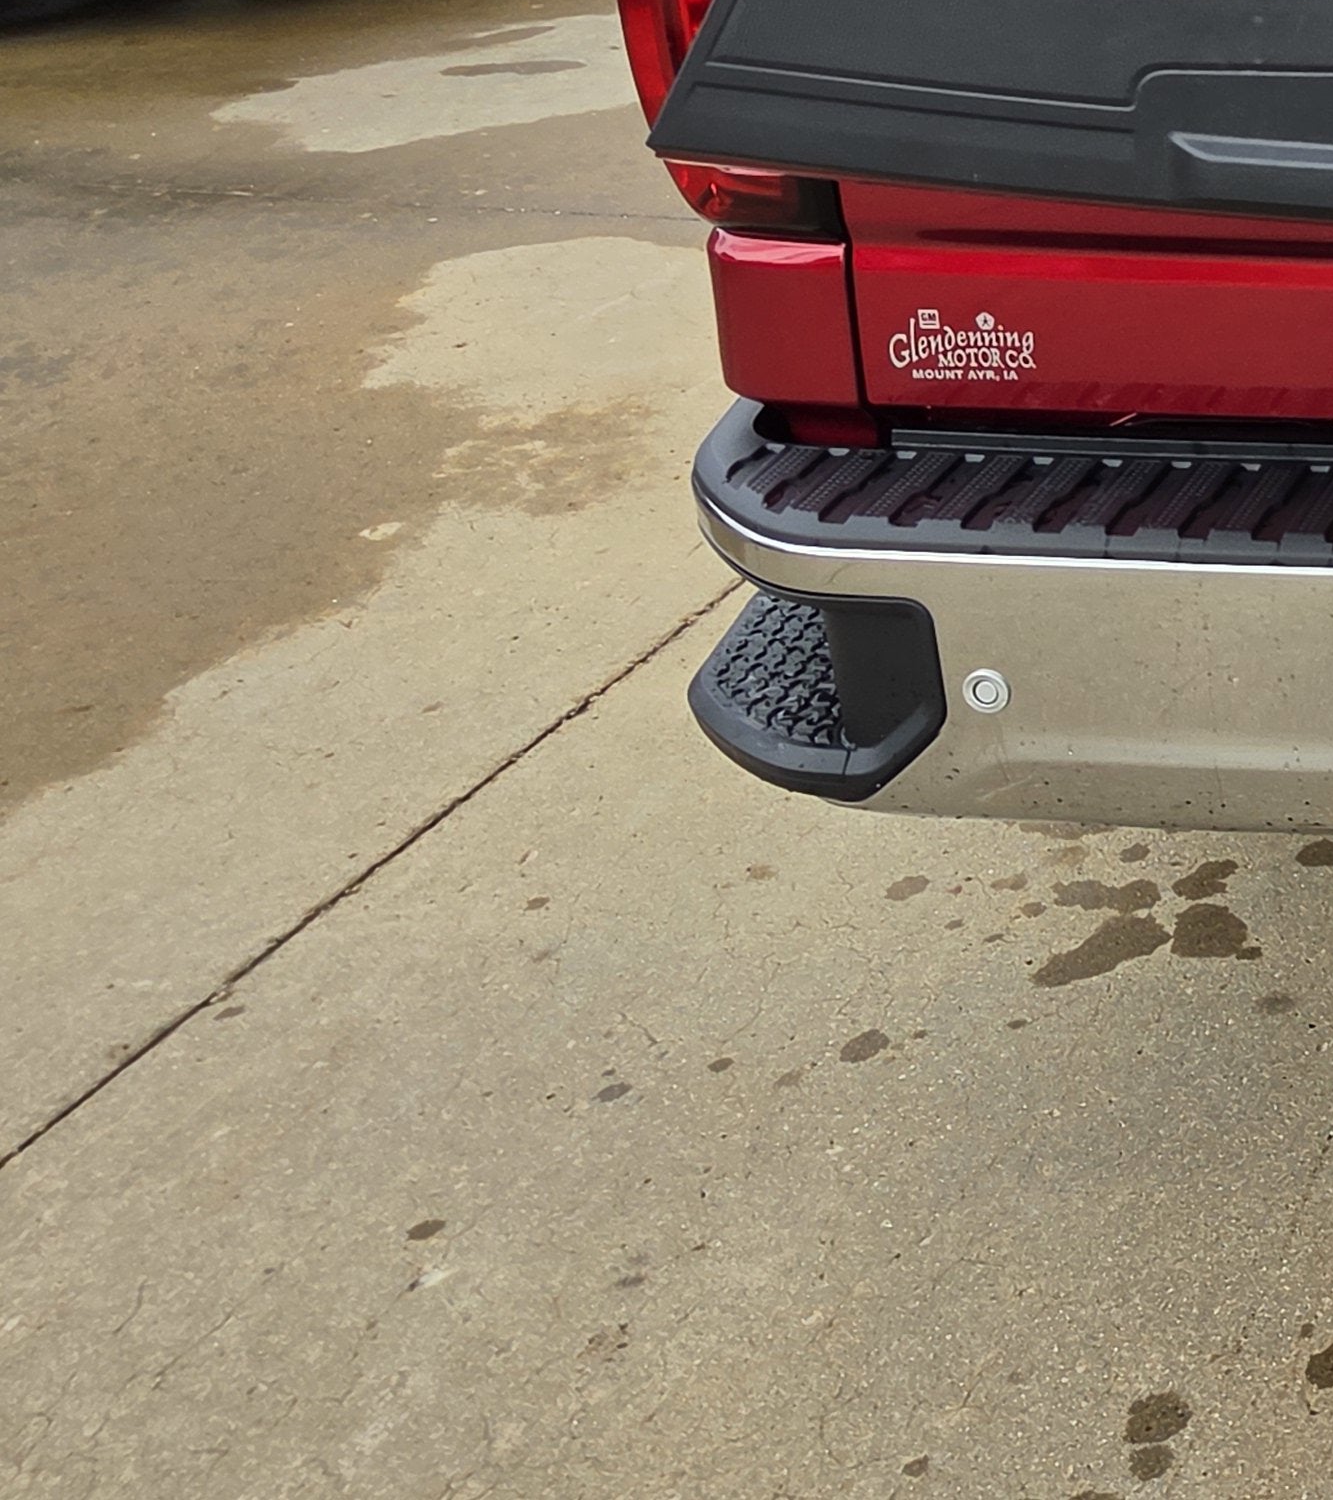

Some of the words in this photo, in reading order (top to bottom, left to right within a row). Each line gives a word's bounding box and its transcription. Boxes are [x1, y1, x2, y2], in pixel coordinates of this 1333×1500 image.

[889, 318, 1034, 369] Glendenning
[938, 347, 1005, 369] MOTOR
[912, 369, 964, 380] MOUNT
[967, 369, 1001, 382] AYR,
[1003, 369, 1019, 380] IA
